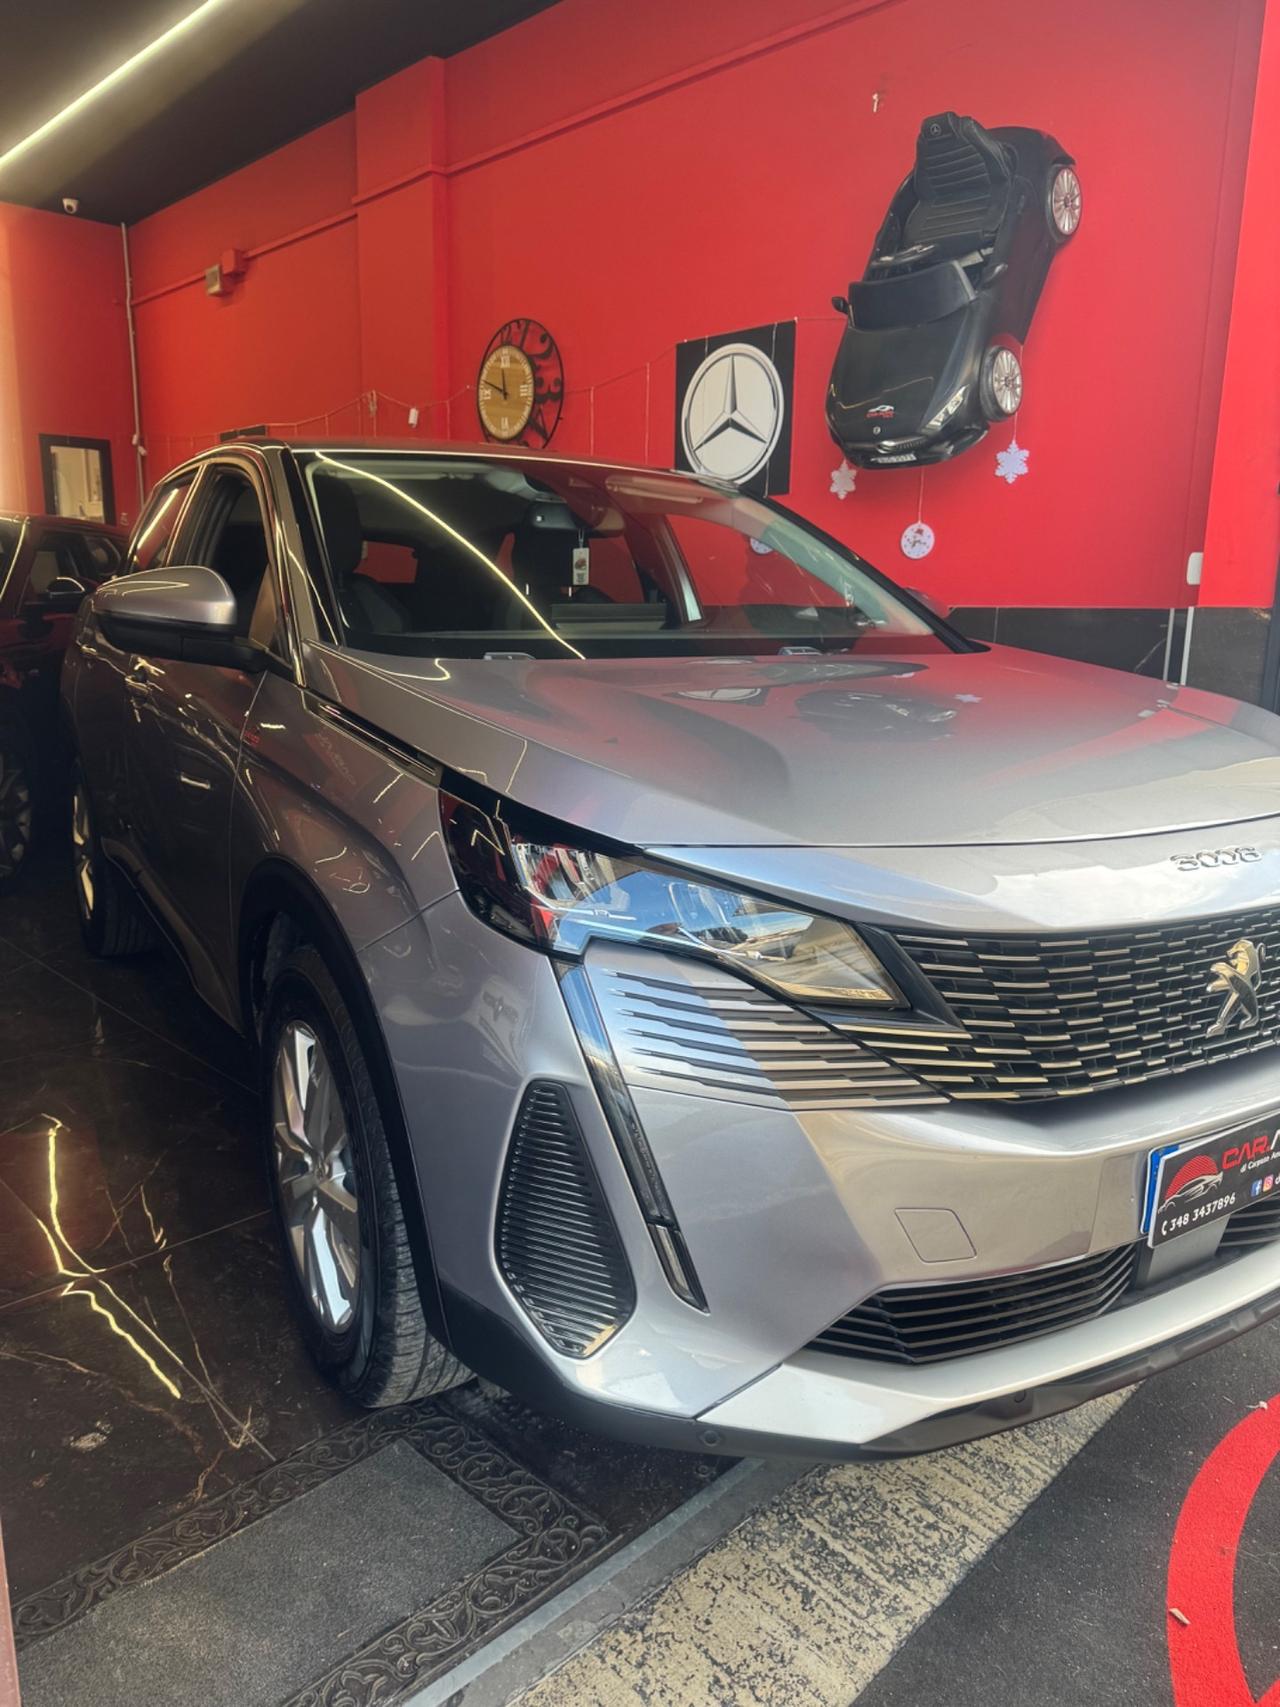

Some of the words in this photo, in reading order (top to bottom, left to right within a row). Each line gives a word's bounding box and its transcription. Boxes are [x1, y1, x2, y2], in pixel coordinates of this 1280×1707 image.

[483, 388, 492, 400] IX
[520, 384, 528, 396] III
[1169, 1213, 1189, 1232] 348
[1192, 1192, 1236, 1222] 3437896
